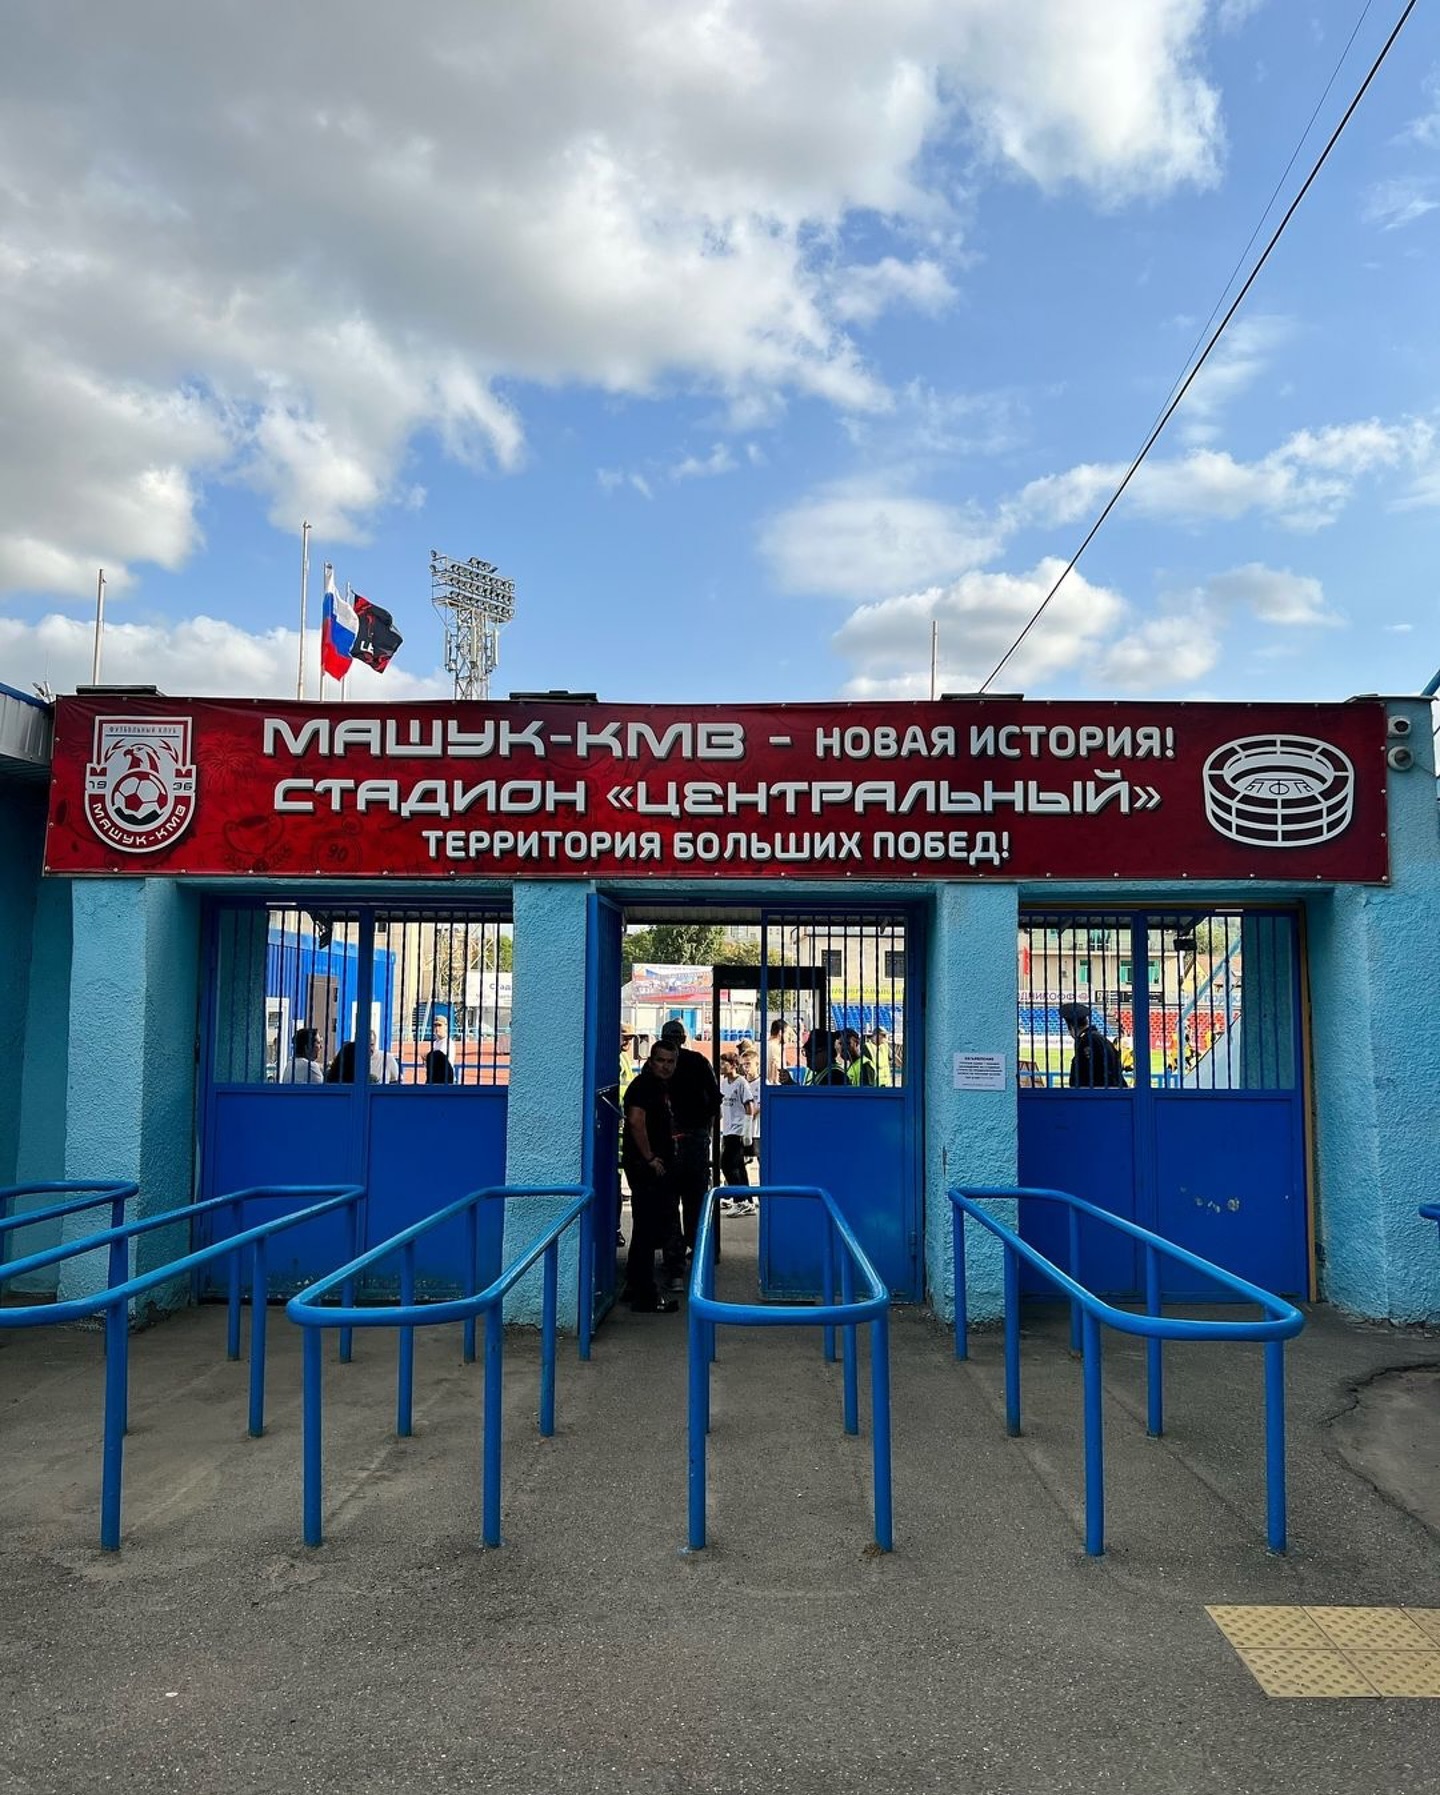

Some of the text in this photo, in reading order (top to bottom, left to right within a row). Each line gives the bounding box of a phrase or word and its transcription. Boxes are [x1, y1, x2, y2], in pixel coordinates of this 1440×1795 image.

[263, 718, 1175, 758] МАШУК-КМВ - НОВАЯ ИСТОРИЯ!
[88, 780, 108, 790] 19
[172, 782, 193, 791] 36
[275, 768, 1162, 818] СТАДИОН «ЦЕНТРАЛЬНЫЙ»
[92, 803, 186, 846] МАШУК-КМВ
[421, 830, 1010, 867] ТЕРРИТОРИЯ БОЛЬШИХ ПОБЕД!
